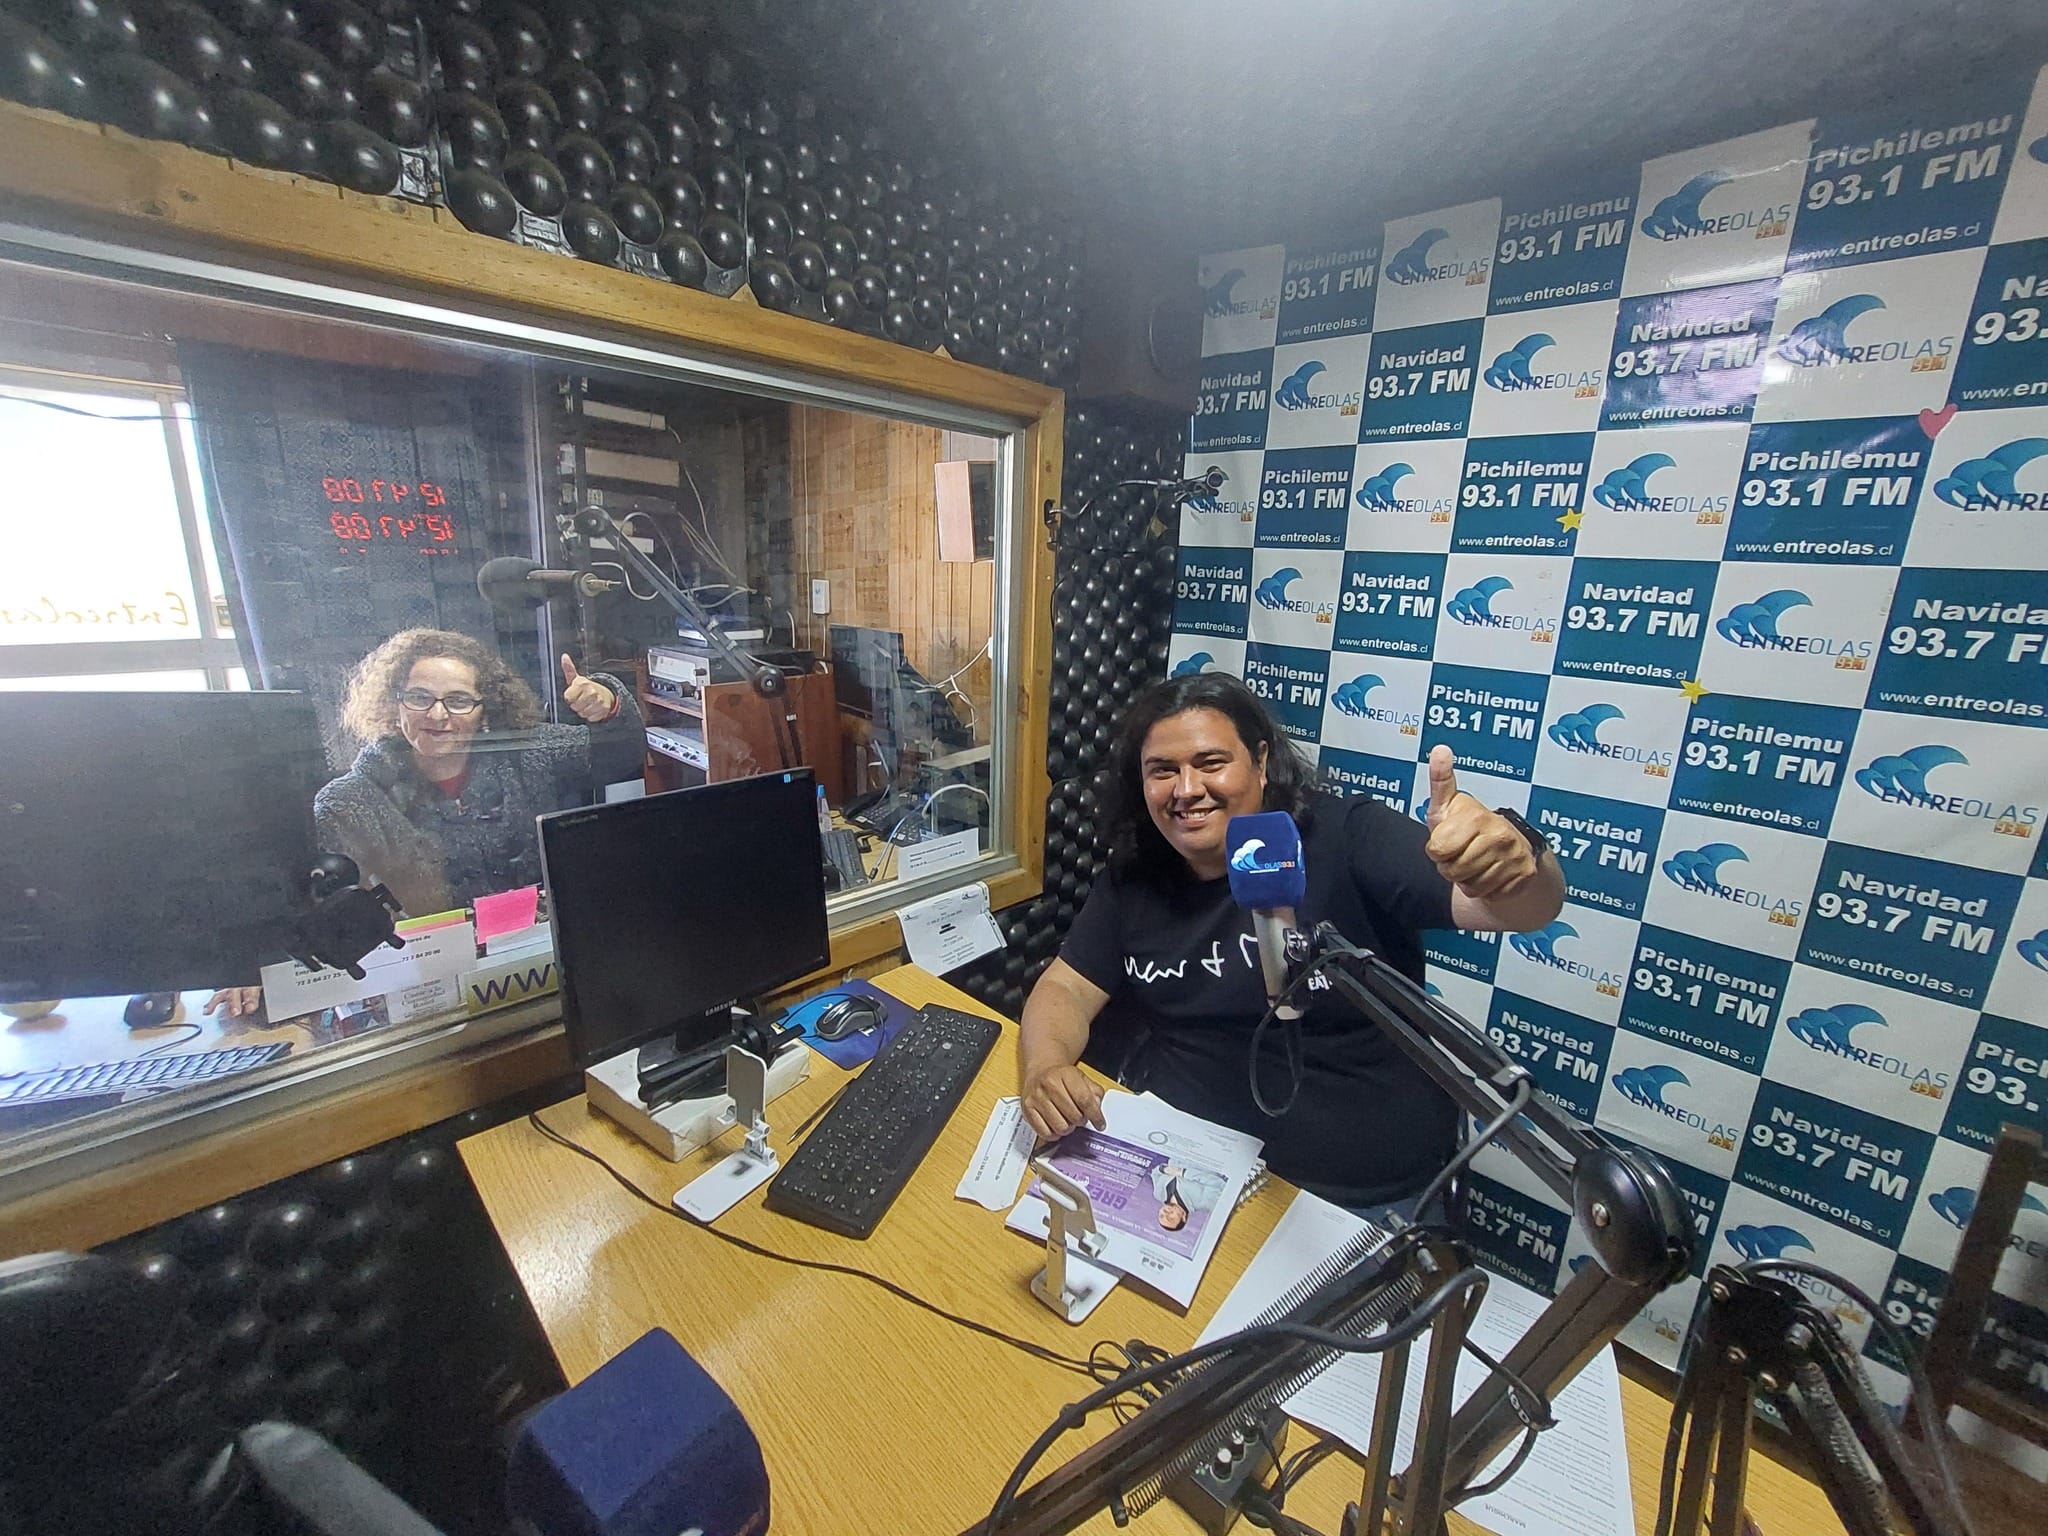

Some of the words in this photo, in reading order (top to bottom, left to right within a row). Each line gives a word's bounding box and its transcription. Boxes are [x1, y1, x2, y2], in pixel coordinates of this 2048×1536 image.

[1813, 114, 2013, 174] Pichilemu
[1806, 164, 1904, 212] 93.1
[1922, 145, 2002, 190] FM
[1503, 197, 1630, 232] Pichilemu
[1662, 202, 1793, 244] ENTREOLAS
[1498, 231, 1562, 264] 93.1
[1574, 217, 1625, 252] FM
[1797, 222, 1982, 263] www.entreolas.cl
[1285, 275, 1329, 302] 93.1
[1339, 264, 1375, 293] FM
[1401, 257, 1490, 286] ENTREOLAS
[1494, 280, 1614, 307] www.entreolas.cl
[1629, 309, 1752, 343] Navidad
[1379, 343, 1466, 370] Navidad
[1611, 345, 1690, 378] 93.7
[1698, 338, 1759, 370] FM
[1199, 369, 1262, 391] Navidad
[1367, 372, 1422, 399] 93.7
[1429, 367, 1471, 393] FM
[1500, 369, 1603, 393] ENTREOLAS
[1235, 385, 1267, 411] FM
[1287, 391, 1361, 411] ENTREOLAS
[1607, 400, 1745, 422] www.entreolas.cl
[1364, 418, 1463, 437] www.entreolas.cl
[1465, 458, 1584, 479] Pichilemu
[1746, 446, 1922, 472] Pichilemu
[1264, 466, 1349, 484] Pichilemu
[1261, 488, 1305, 508] 93.1
[1312, 487, 1346, 507] FM
[1371, 499, 1453, 513] ENTREOLAS
[1460, 484, 1522, 507] 93.1
[1531, 482, 1579, 507] FM
[1612, 496, 1730, 512] ENTREOLAS
[1739, 479, 1828, 506] 93.1
[1841, 477, 1911, 506] FM
[1259, 532, 1340, 543] www.entreolas.cl
[1457, 535, 1569, 549] www.entreolas.cl
[1734, 540, 1895, 557] www.entreolas.cl
[1184, 565, 1243, 580] Navidad
[1351, 571, 1431, 590] Navidad
[1176, 581, 1214, 601] 93.7
[1220, 583, 1247, 603] FM
[1340, 591, 1391, 614] 93.7
[1397, 595, 1436, 617] FM
[1582, 582, 1694, 605] Navidad
[1265, 599, 1334, 616] ENTREOLAS
[1565, 606, 1637, 633] 93.7
[1645, 610, 1700, 638] FM
[1176, 620, 1243, 634] www.entreolas.cl
[1463, 612, 1557, 633] ENTREOLAS
[1338, 637, 1428, 654] www.entreolas.cl
[1737, 631, 1874, 658] ENTREOLAS
[1889, 626, 1994, 659] 93.7
[1247, 660, 1324, 683] Pichilemu
[1561, 659, 1686, 681] www.entreolas.cl
[1246, 678, 1283, 700] 93.1
[1290, 685, 1322, 707] FM
[1431, 683, 1540, 712] Pichilemu
[1344, 703, 1421, 726] ENTREOLAS
[1427, 703, 1483, 731] 93.1
[1492, 712, 1535, 739] FM
[1687, 716, 1845, 755] Pichilemu
[1566, 736, 1673, 765] ENTREOLAS
[1682, 740, 1761, 775] 93.1
[1773, 753, 1836, 786] FM
[1328, 766, 1401, 793] Navidad
[1678, 795, 1822, 830] www.entreolas.cl
[1880, 791, 2039, 824] ENTREOLAS
[1540, 809, 1642, 844] Navidad
[1541, 830, 1591, 860] 3.7
[1599, 844, 1648, 874] FM
[1682, 876, 1804, 917] ENTREOLAS
[1837, 869, 1989, 918] Navidad
[1813, 891, 1910, 936] 93.7
[1919, 915, 1995, 955] FM
[1425, 949, 1490, 976] ntreolas.cl
[1525, 948, 1623, 988] ENTREOLAS
[1637, 945, 1778, 1000] Pichilemu
[1807, 948, 1975, 1000] www.entreolas.cl
[705, 998, 738, 1017] SAMSUNG
[1631, 966, 1703, 1007] 93.1
[1713, 991, 1770, 1028] FM
[1501, 1011, 1594, 1055] Navidad
[1627, 1016, 1756, 1066] www.entreolas.cl
[1489, 1027, 1548, 1062] 93.7
[1555, 1051, 1599, 1083] FM
[1809, 1034, 1951, 1090] ENTREOLAS
[1966, 1067, 2048, 1112] 93.
[1630, 1091, 1740, 1142] ENTREOLAS
[1769, 1105, 1904, 1167] Navidad
[1748, 1122, 1833, 1172] 93.7
[1842, 1157, 1910, 1202] FM
[1468, 1188, 1552, 1238] Navidad
[1742, 1171, 1892, 1240] www.entreolas.cl
[1517, 1229, 1557, 1264] FM
